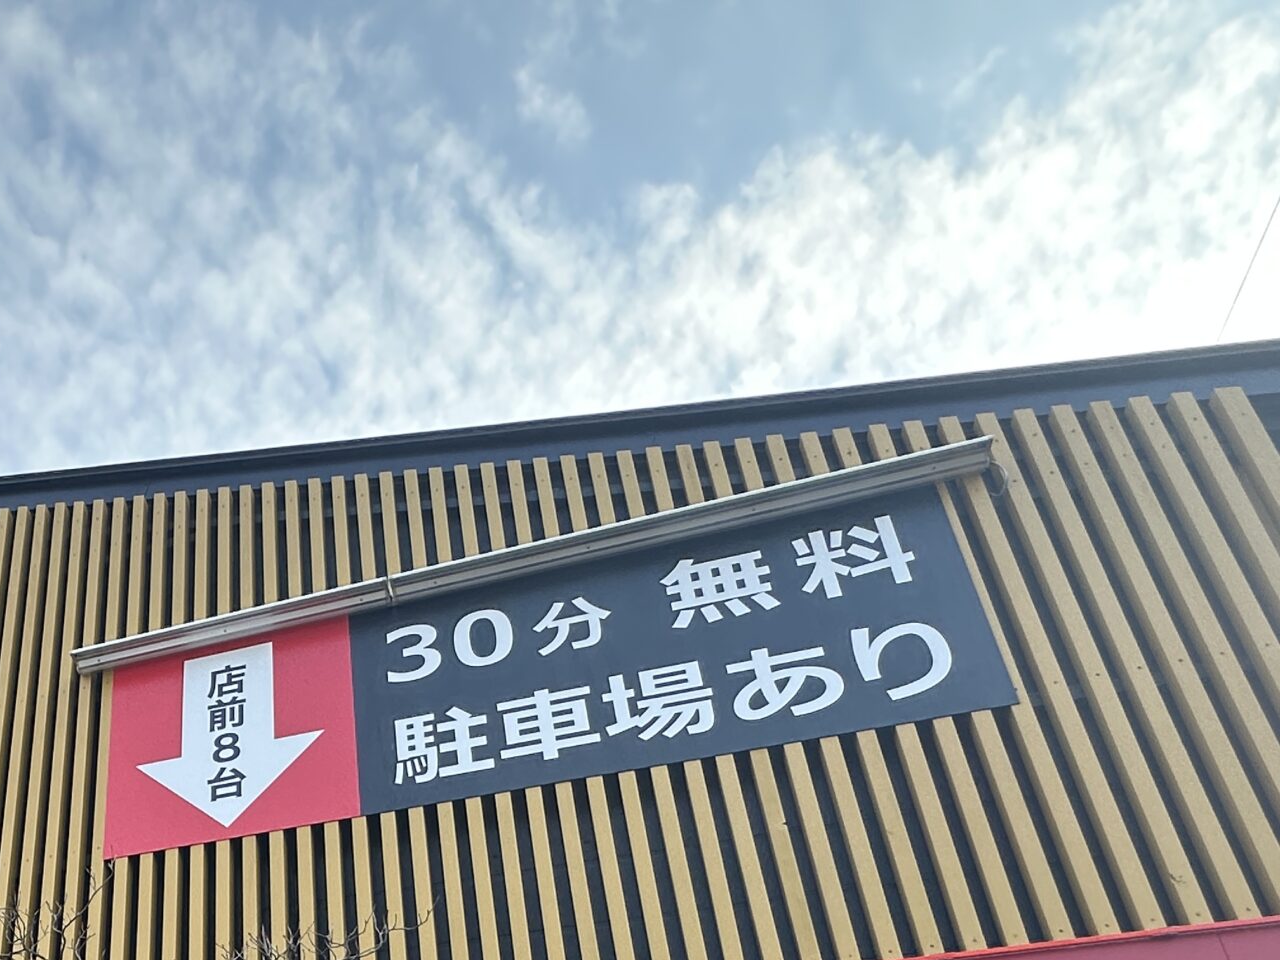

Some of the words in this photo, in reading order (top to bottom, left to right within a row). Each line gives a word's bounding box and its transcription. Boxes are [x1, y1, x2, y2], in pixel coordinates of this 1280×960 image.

[386, 596, 612, 685] 30分
[659, 514, 915, 629] 無料
[207, 664, 247, 802] 店前8台
[393, 620, 954, 786] 駐車場あり
